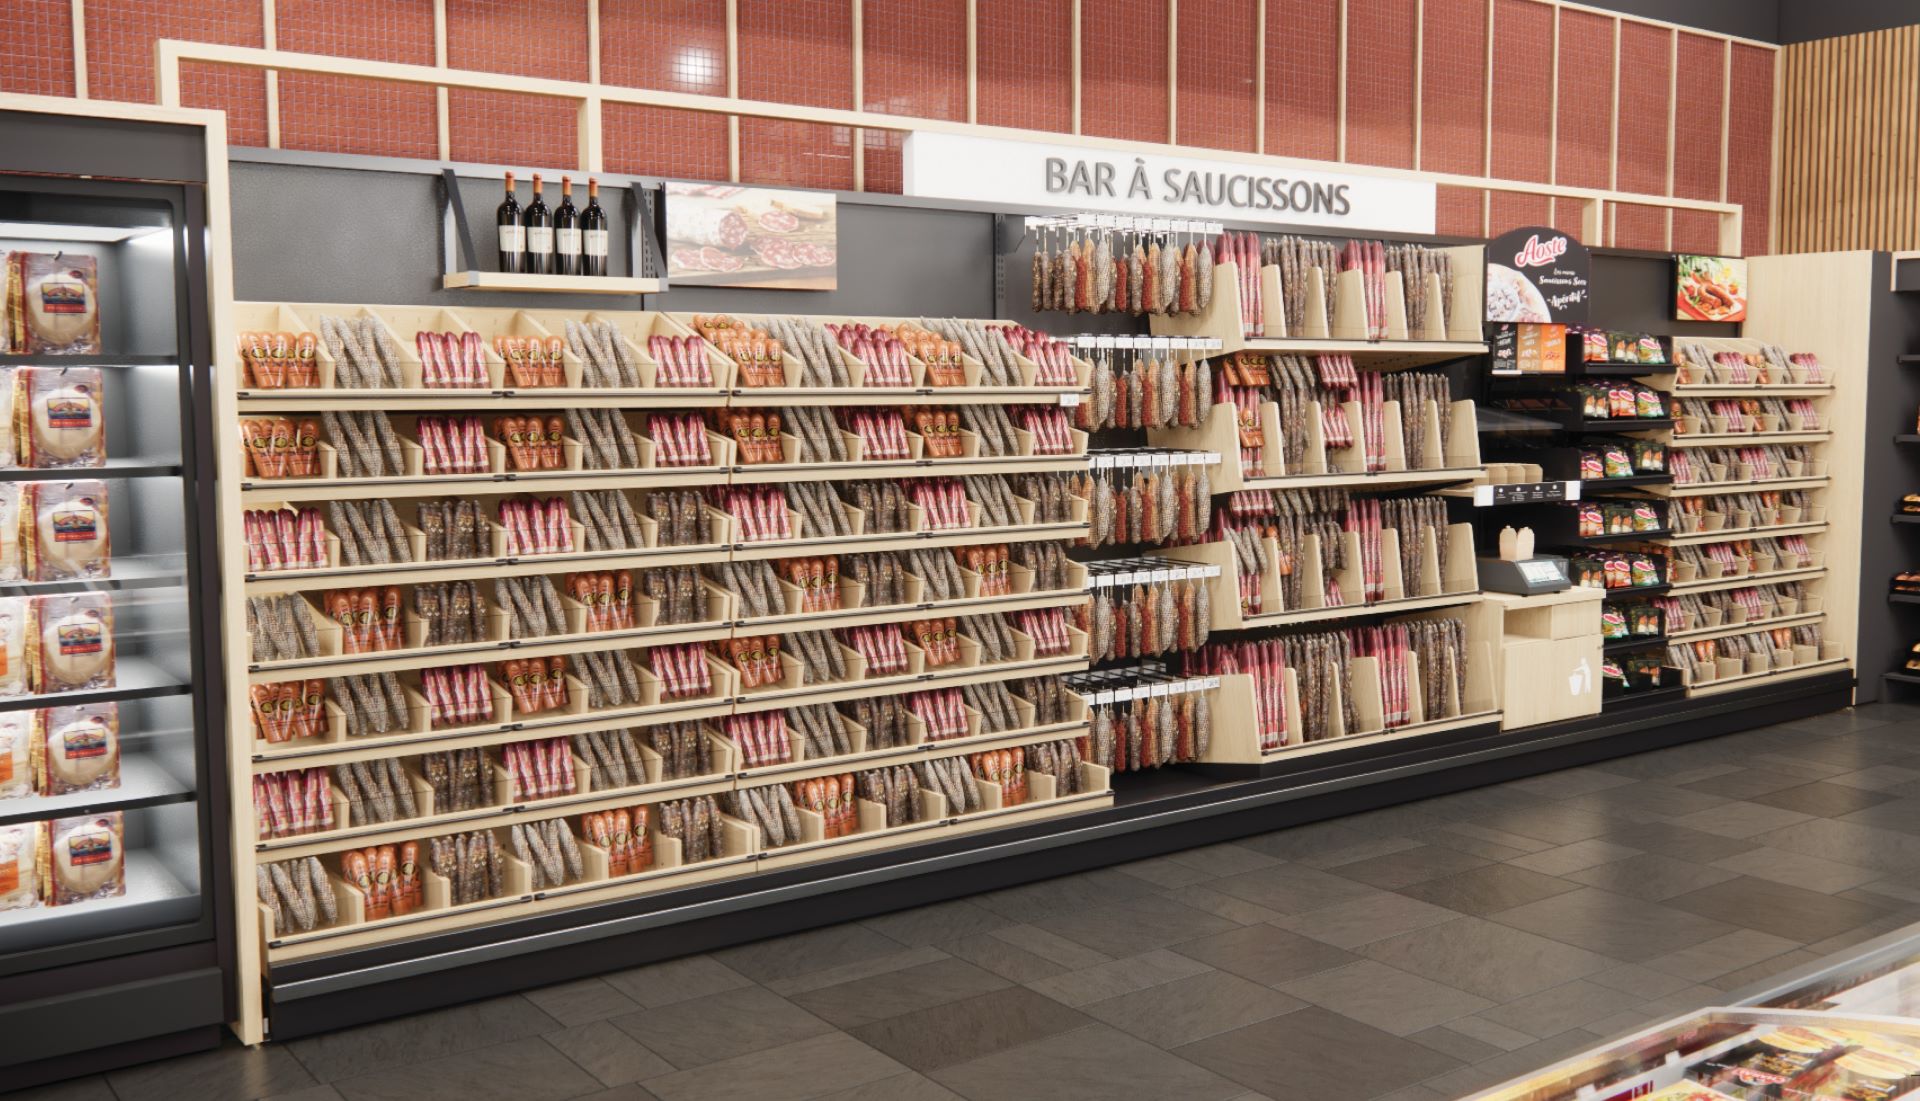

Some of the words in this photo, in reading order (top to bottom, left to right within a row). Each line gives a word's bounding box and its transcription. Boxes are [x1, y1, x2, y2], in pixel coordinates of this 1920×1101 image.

[1046, 158, 1116, 197] BAR
[1128, 158, 1152, 200] À
[1163, 169, 1350, 215] SAUCISSONS
[1515, 235, 1567, 267] Aoste
